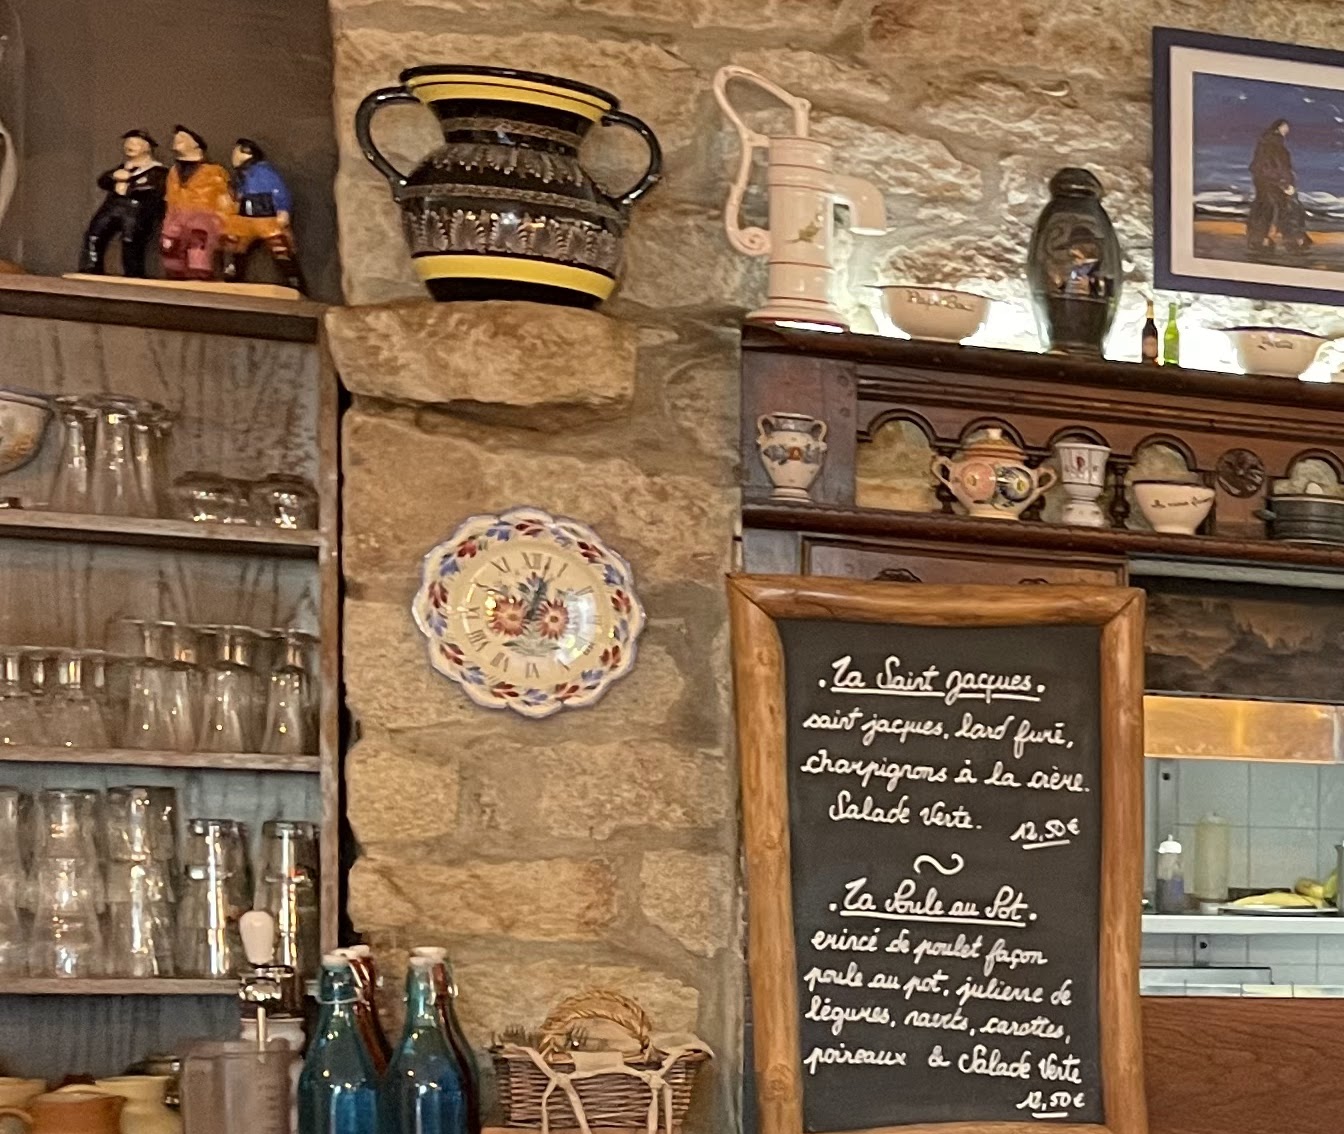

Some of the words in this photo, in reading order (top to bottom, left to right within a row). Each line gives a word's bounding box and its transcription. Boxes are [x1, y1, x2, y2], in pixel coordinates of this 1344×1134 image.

[831, 655, 866, 688] La
[876, 655, 940, 691] Saint
[803, 707, 863, 730] saint
[955, 712, 1015, 740] lard
[800, 749, 948, 792] champignons
[954, 760, 977, 784] à
[984, 760, 1022, 787] la
[829, 790, 910, 824] Salade
[843, 877, 876, 911] La
[884, 879, 944, 917] Poule
[948, 902, 979, 917] au
[885, 929, 910, 953] de
[913, 933, 984, 964] poulet
[984, 938, 1048, 977] façon
[803, 961, 863, 992] poule
[868, 971, 900, 990] au
[1050, 979, 1073, 1005] de
[979, 1015, 1071, 1044] carottes,
[803, 1043, 907, 1075] poireaux
[928, 1044, 951, 1068] &
[958, 1044, 1032, 1079] Salade
